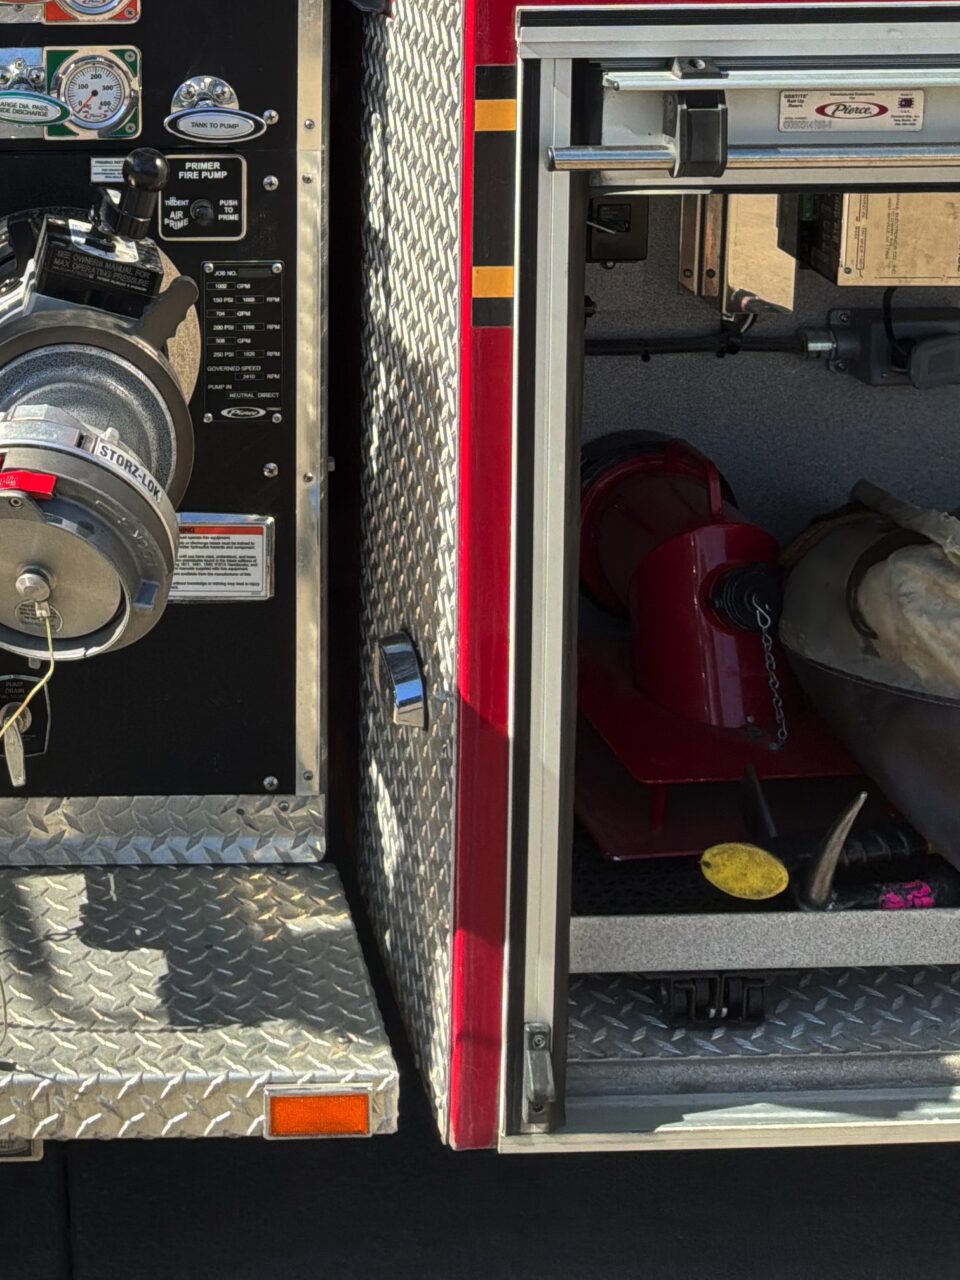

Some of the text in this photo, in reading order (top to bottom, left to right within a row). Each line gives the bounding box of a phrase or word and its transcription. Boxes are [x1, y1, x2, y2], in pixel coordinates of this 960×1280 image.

[12, 109, 48, 117] DISCHARGE
[833, 103, 872, 116] Pierce
[185, 162, 220, 170] PRIMER
[202, 171, 227, 179] PUMP
[170, 211, 184, 220] AIR
[164, 218, 188, 230] PRIME
[73, 253, 103, 266] OWNERS
[105, 263, 132, 274] MANUAL
[135, 271, 150, 279] FOR
[72, 262, 111, 277] OPERATING
[113, 273, 150, 286] PRESSURE
[100, 446, 160, 500] STORZ-LOK
